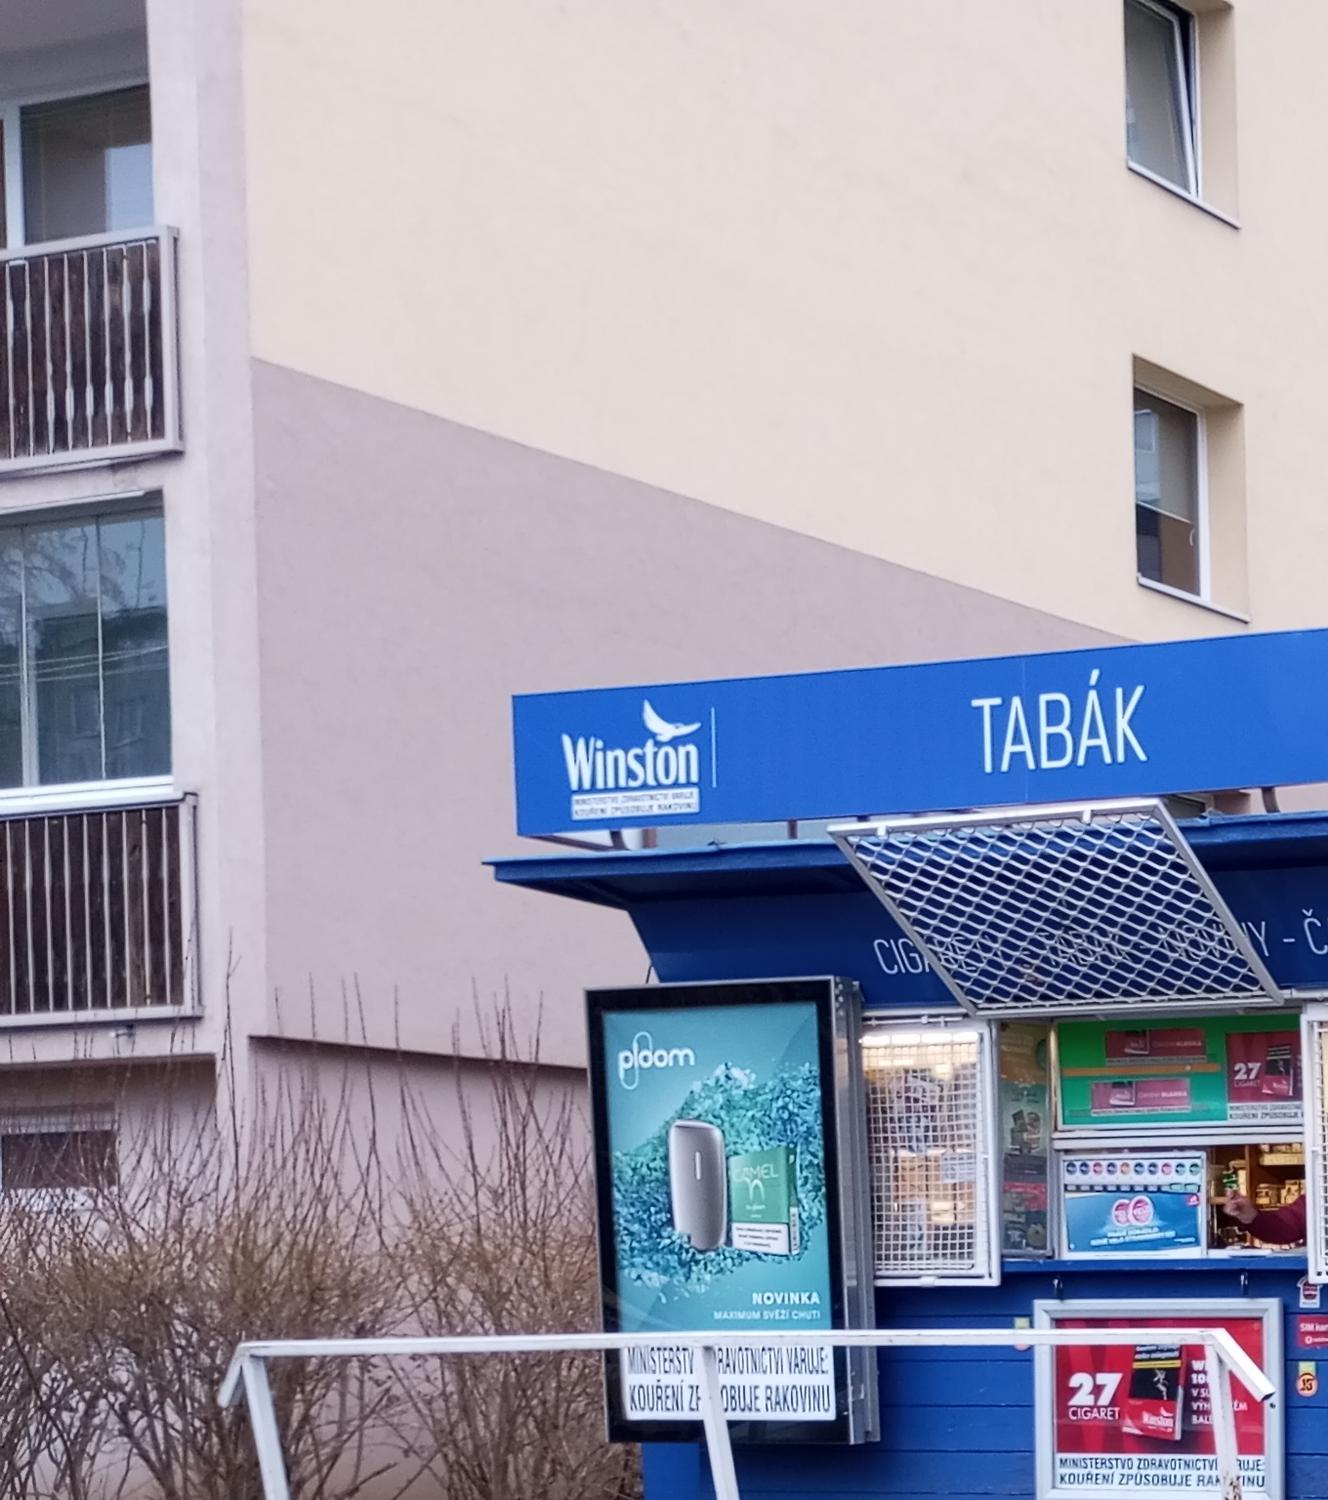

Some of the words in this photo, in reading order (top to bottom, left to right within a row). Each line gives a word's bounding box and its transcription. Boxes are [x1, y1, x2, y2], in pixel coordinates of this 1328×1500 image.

[970, 668, 1148, 774] TABÁK
[561, 733, 699, 791] Winston
[617, 1031, 696, 1091] ploom
[1233, 1062, 1262, 1081] 27
[752, 1291, 821, 1305] NOVINKA
[713, 1310, 761, 1320] MAXIMUM
[763, 1308, 790, 1320] SVĚŽÍ
[791, 1309, 821, 1320] CHUTI
[627, 1346, 694, 1375] MINISTERSTV
[716, 1346, 784, 1375] RAVOTNICTV
[786, 1346, 829, 1375] VARUJE:
[628, 1378, 684, 1413] KOUŘENÍ
[687, 1384, 761, 1413] ZPOBUJE
[764, 1383, 831, 1413] RAKOVINU
[1066, 1371, 1123, 1407] 27
[1068, 1406, 1121, 1421] CIGARET
[1191, 1399, 1248, 1412] VÝHÉM
[1058, 1457, 1134, 1470] MINISTERSTVO
[1136, 1456, 1218, 1472] ZDRAVOTNICTVÍ
[1237, 1458, 1266, 1472] RUJE:
[1058, 1471, 1115, 1486] KOUŘENÍ
[1118, 1470, 1192, 1487] ZPŮSOBUJE
[1196, 1473, 1266, 1488] RAKINU
